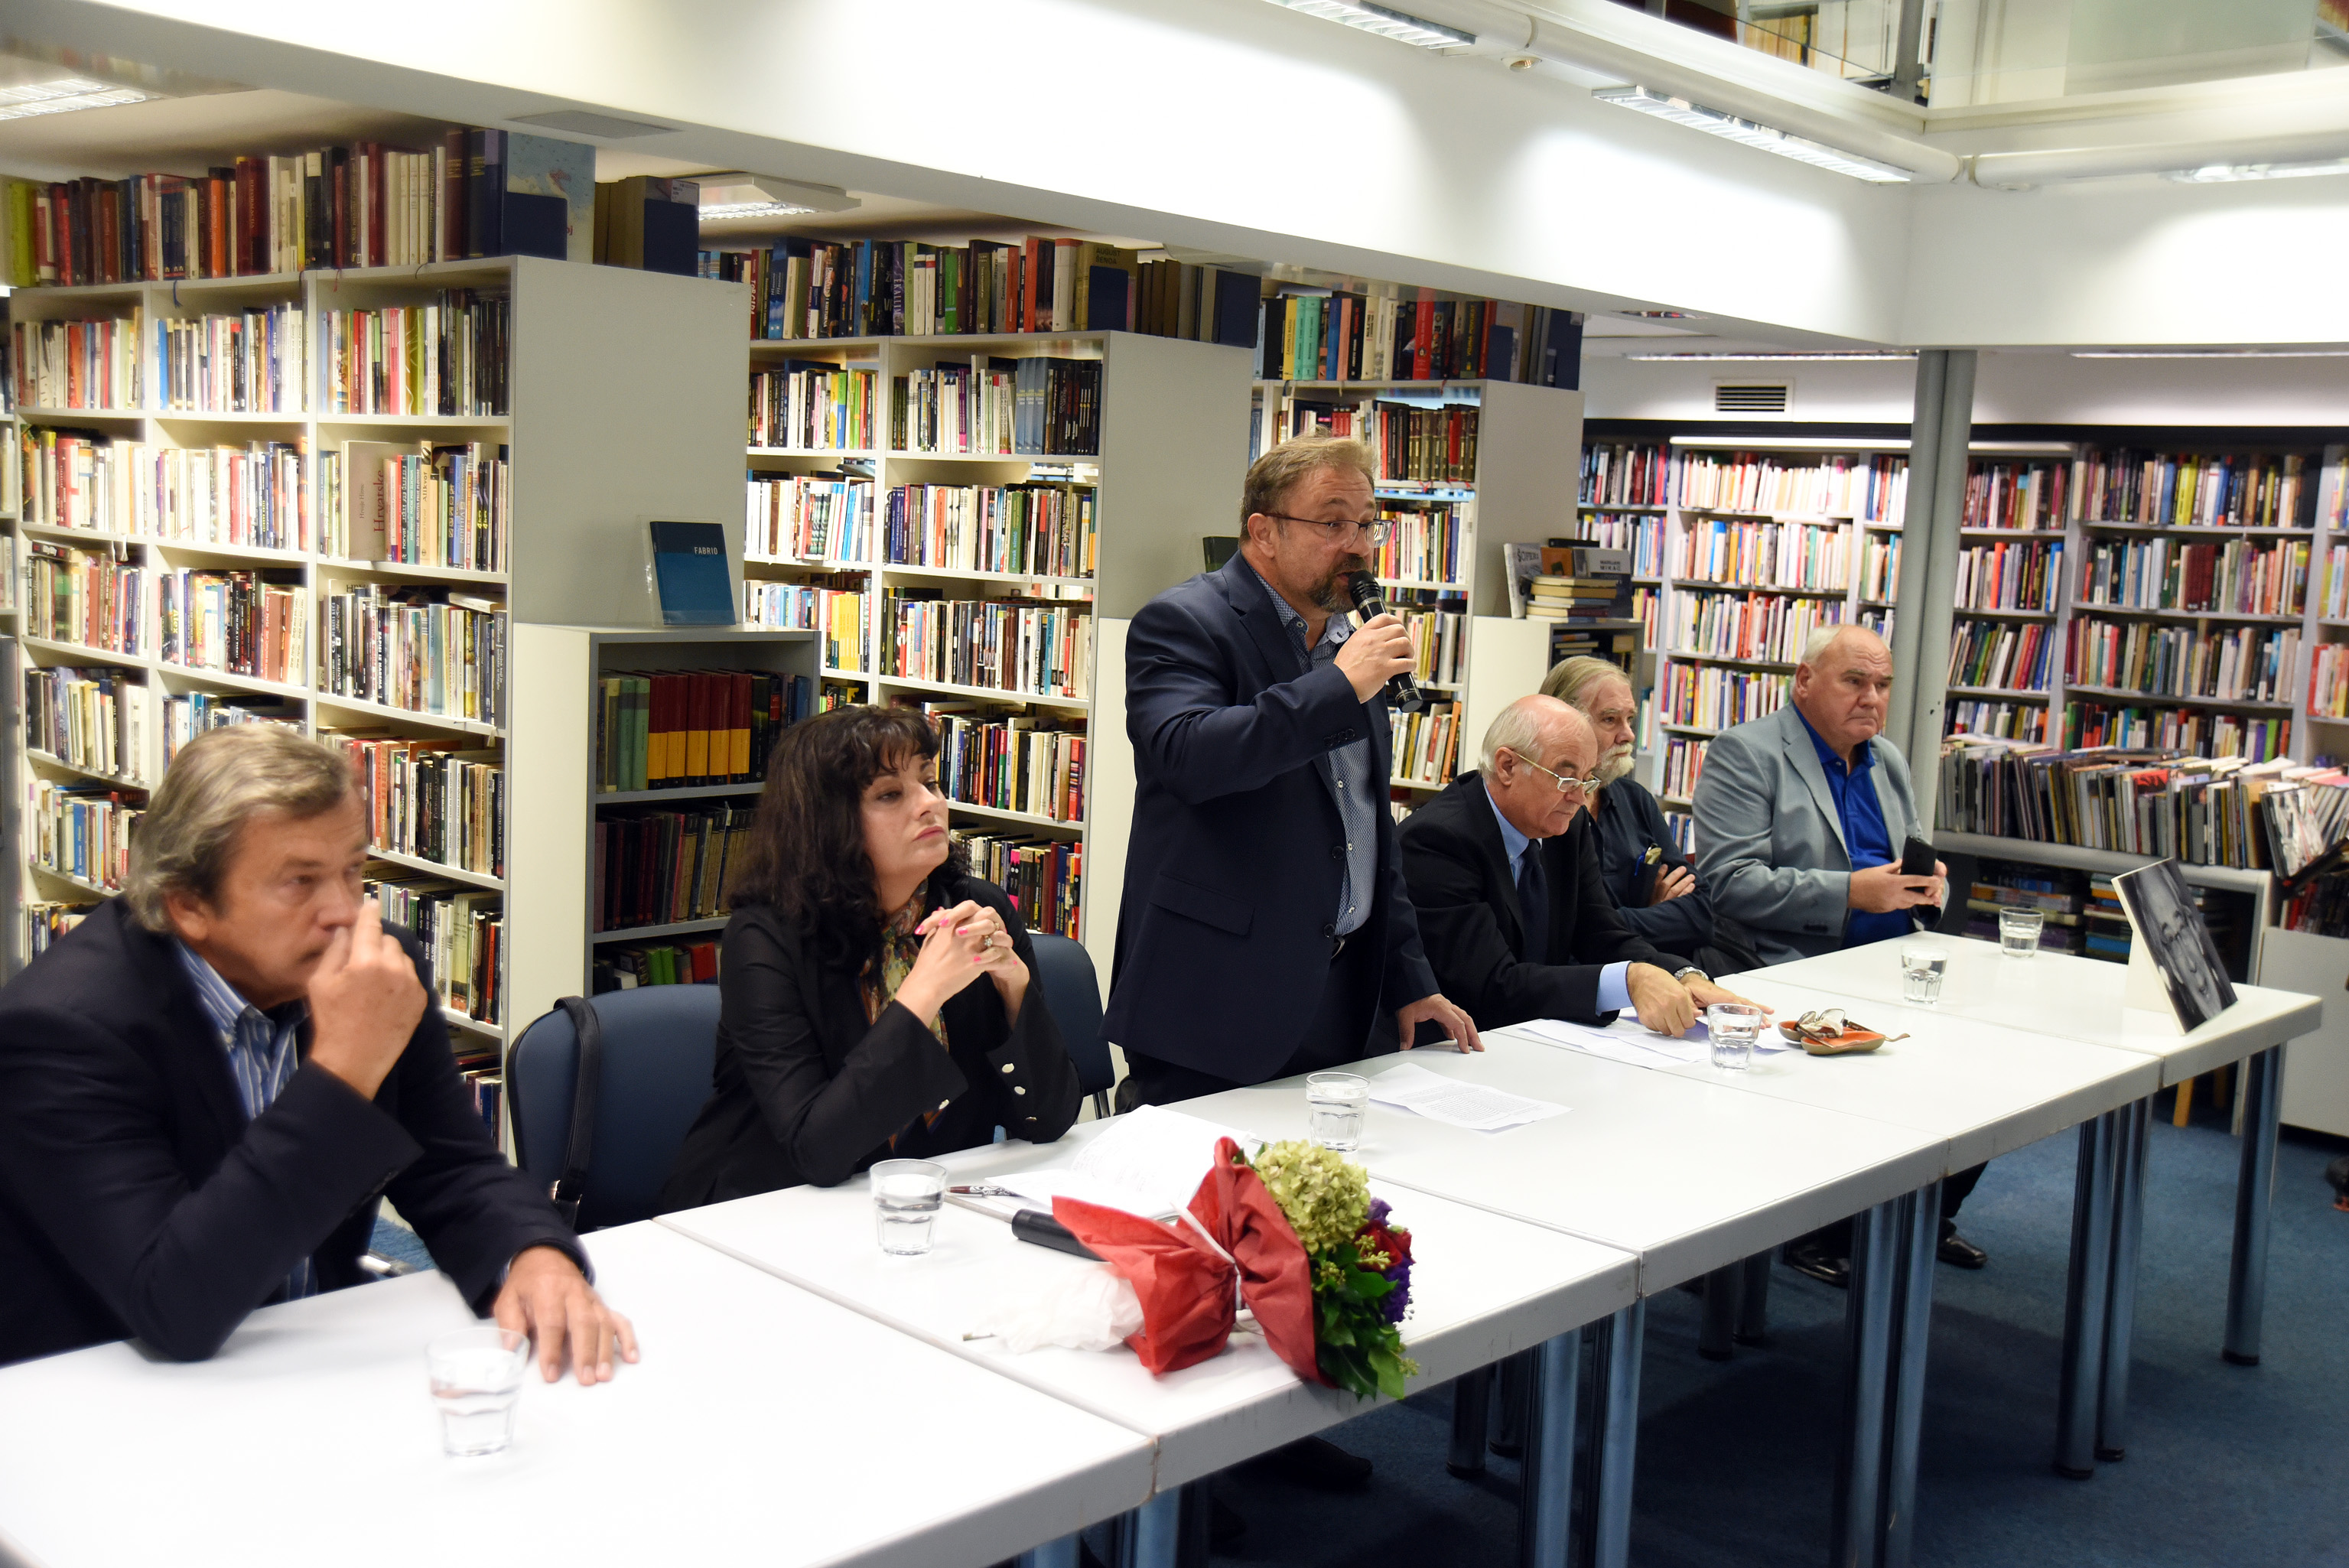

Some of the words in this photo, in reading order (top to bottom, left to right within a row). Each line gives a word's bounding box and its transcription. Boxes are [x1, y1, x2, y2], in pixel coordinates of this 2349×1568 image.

[1095, 246, 1121, 257] AUGUST
[373, 470, 386, 532] Hrvatske
[694, 546, 719, 556] FABRIO
